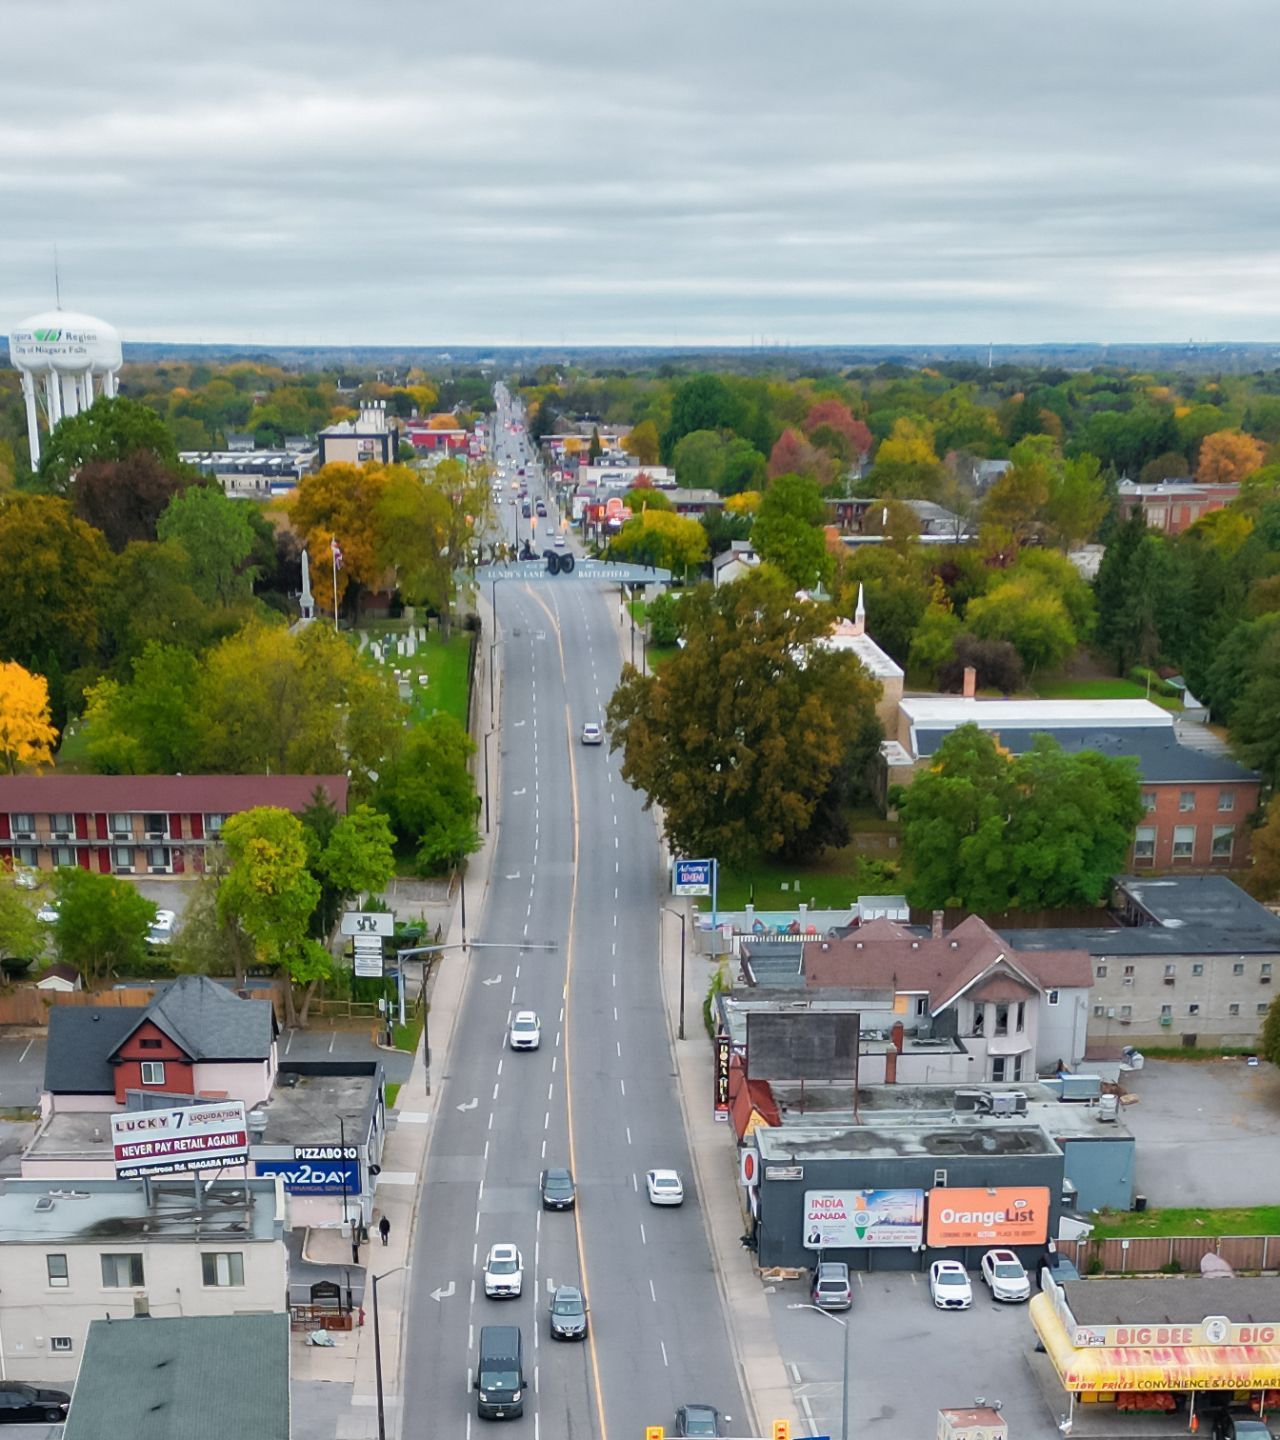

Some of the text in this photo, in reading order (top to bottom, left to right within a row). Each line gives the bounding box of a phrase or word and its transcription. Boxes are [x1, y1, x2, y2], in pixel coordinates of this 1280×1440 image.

[116, 1110, 240, 1131] LUCKY 7 LIQUIDATION
[122, 1134, 238, 1157] NEVER PAY RETAIL AGAIN!
[188, 1159, 221, 1170] NIAGARA
[811, 1199, 844, 1208] INDIA
[940, 1208, 1035, 1227] OrangeList
[1116, 1328, 1151, 1344] BIG
[1157, 1328, 1192, 1344] BEE
[1240, 1328, 1275, 1342] BIG
[1138, 1378, 1280, 1389] CONVENIENCE & FOOD MART
